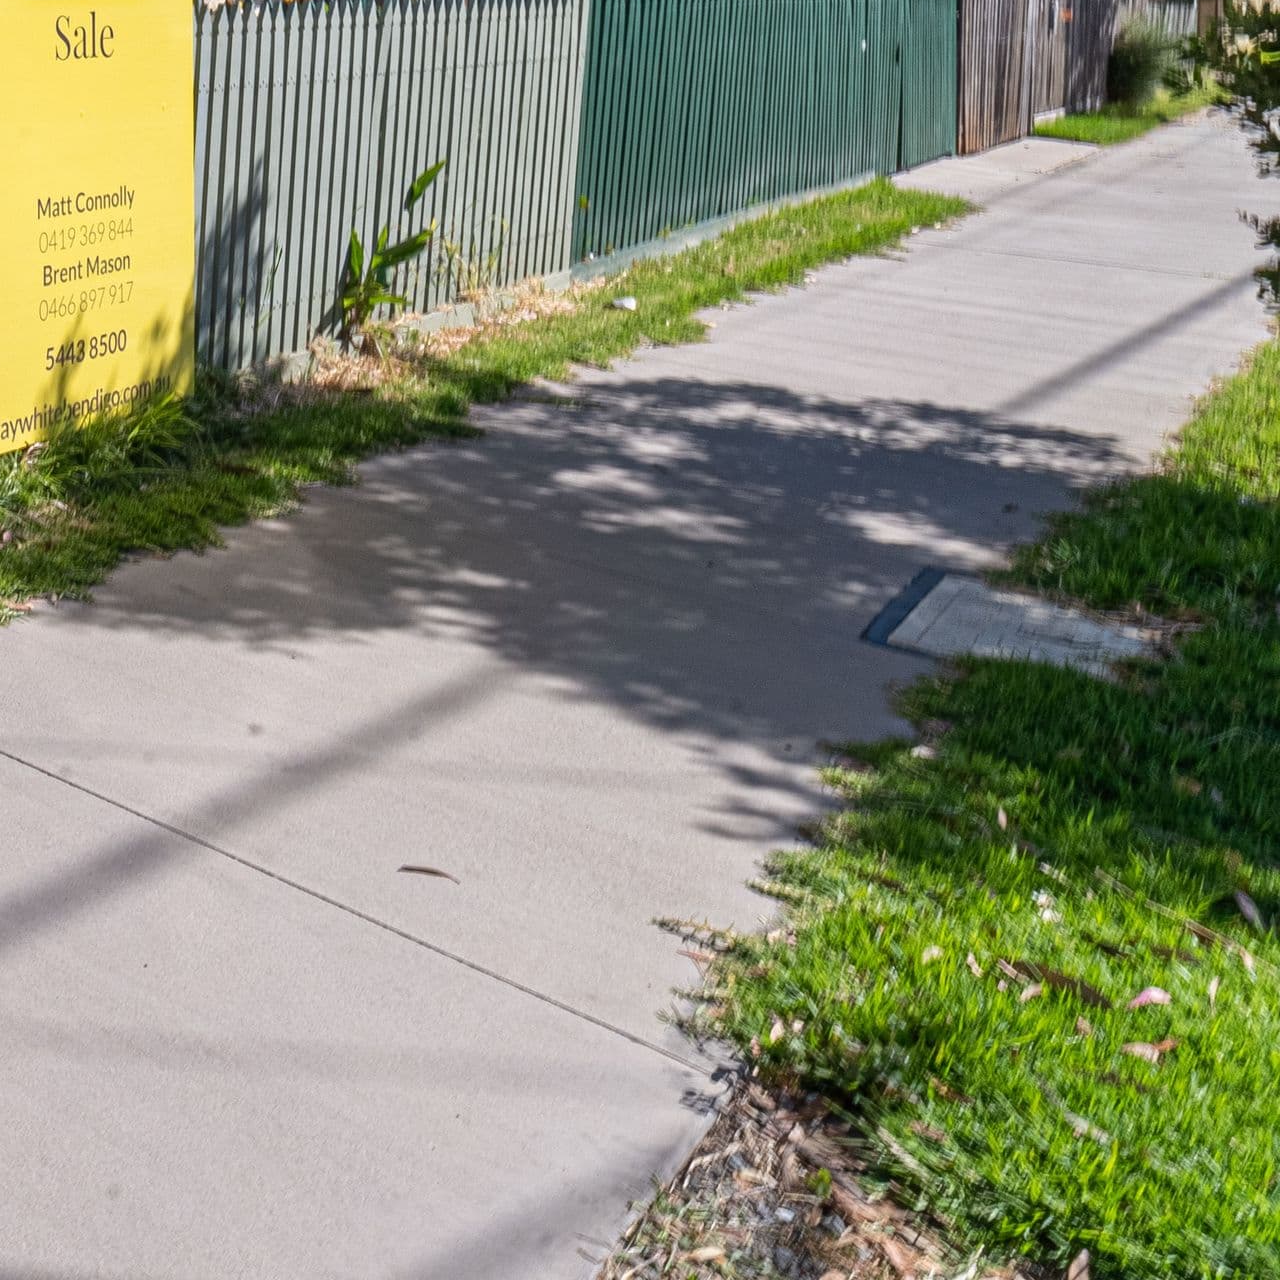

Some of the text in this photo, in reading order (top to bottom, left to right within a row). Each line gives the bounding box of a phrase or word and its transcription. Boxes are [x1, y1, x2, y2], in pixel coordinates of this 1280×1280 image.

[55, 11, 115, 61] Sale
[37, 185, 135, 220] Matt Connolly
[38, 217, 134, 254] 0419 369 844
[43, 255, 131, 287] Brent Mason
[39, 281, 134, 322] 0466 897 917
[45, 329, 127, 371] 5443 8500
